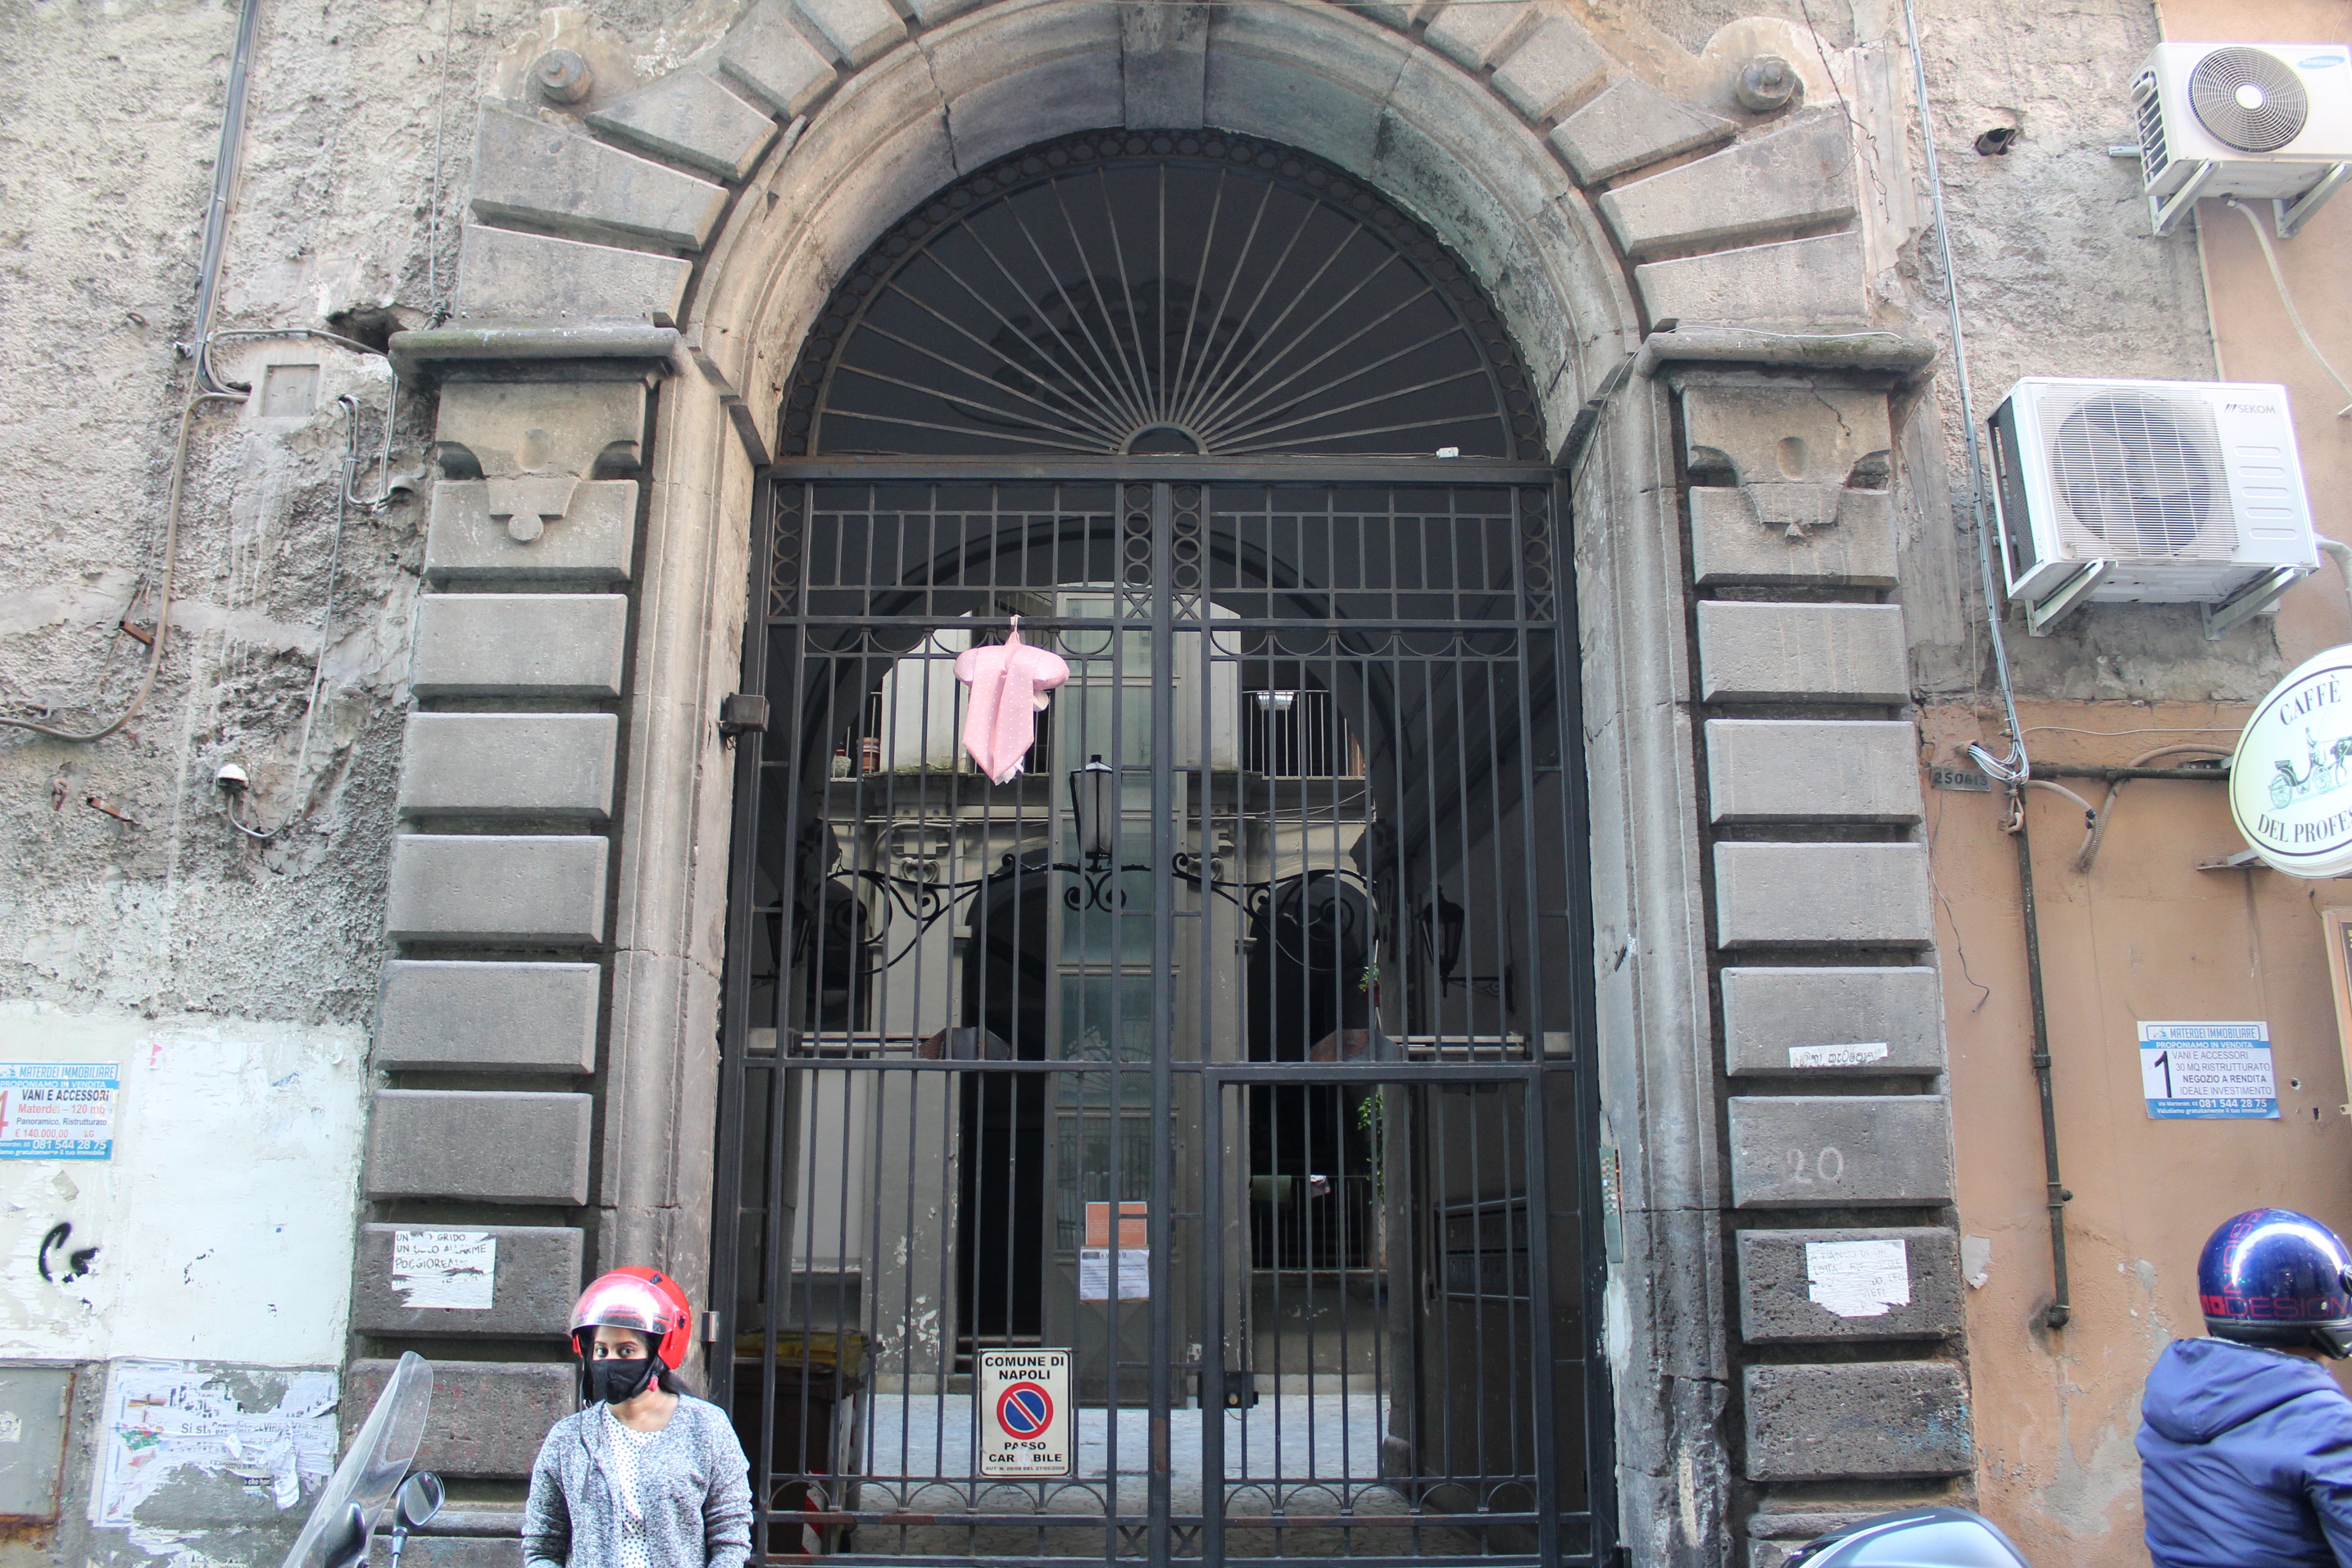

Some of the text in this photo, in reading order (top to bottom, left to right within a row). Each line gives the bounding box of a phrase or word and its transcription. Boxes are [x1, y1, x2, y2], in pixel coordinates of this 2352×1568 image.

[2238, 404, 2275, 414] SEKOM
[2280, 674, 2340, 725] CAFFÈ
[2257, 812, 2288, 842] DEL
[2170, 1028, 2256, 1039] MATERDEI IMMOBILIARE
[2172, 1051, 2248, 1059] VANI E ACCESSORI
[19, 1067, 114, 1078] MATERDEI IMMOBILIARE
[2176, 1063, 2270, 1072] 30 MQ RISTRUTTURATO
[2154, 1050, 2172, 1098] 1
[2183, 1075, 2266, 1083] NEGOZIO A RENDITA
[23, 1089, 109, 1101] VANI E ACCESSORI
[2180, 1087, 2272, 1095] IDEALE INVESTIMENTO
[2199, 1099, 2216, 1107] 081
[2219, 1099, 2238, 1107] 544
[2240, 1099, 2252, 1107] 28
[2255, 1099, 2267, 1107] 75
[18, 1103, 60, 1113] Materdei
[72, 1104, 87, 1113] 120
[90, 1106, 105, 1115] mq
[16, 1117, 60, 1126] Panoramico,
[15, 1128, 21, 1138] €
[24, 1129, 69, 1139] 140.000,00
[33, 1140, 51, 1149] 081
[55, 1140, 75, 1149] 544
[77, 1140, 90, 1149] 28
[94, 1140, 107, 1150] 75
[397, 1233, 409, 1241] UN
[397, 1244, 409, 1252] UN
[1821, 1250, 1856, 1260] FIANCO
[985, 1356, 1064, 1366] COMUNE DI
[999, 1370, 1050, 1379] NAPOLI
[181, 1423, 193, 1433] Si
[1005, 1442, 1046, 1450] PASSO
[989, 1454, 1062, 1462] CARBILE
